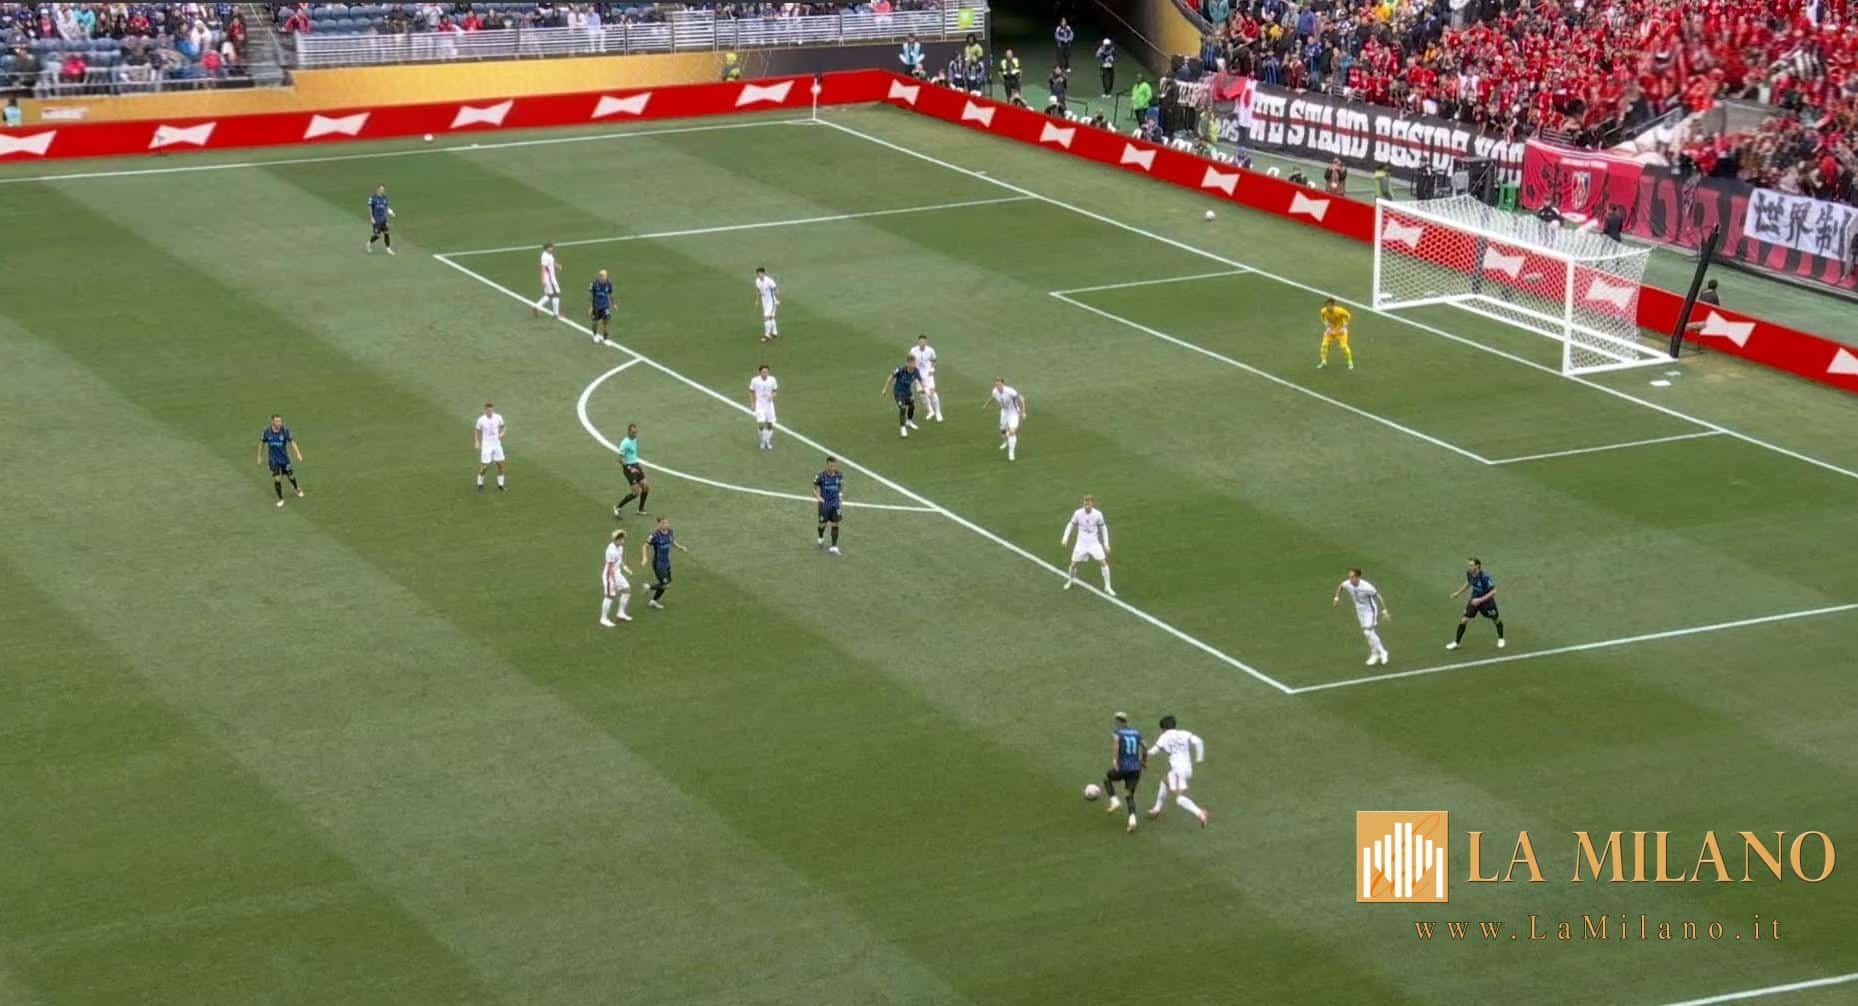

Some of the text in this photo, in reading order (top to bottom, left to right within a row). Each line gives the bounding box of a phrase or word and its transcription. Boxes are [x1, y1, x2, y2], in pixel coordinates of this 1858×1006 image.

[1249, 92, 1287, 144] WE
[1287, 98, 1369, 159] STAND
[1123, 735, 1137, 754] 11
